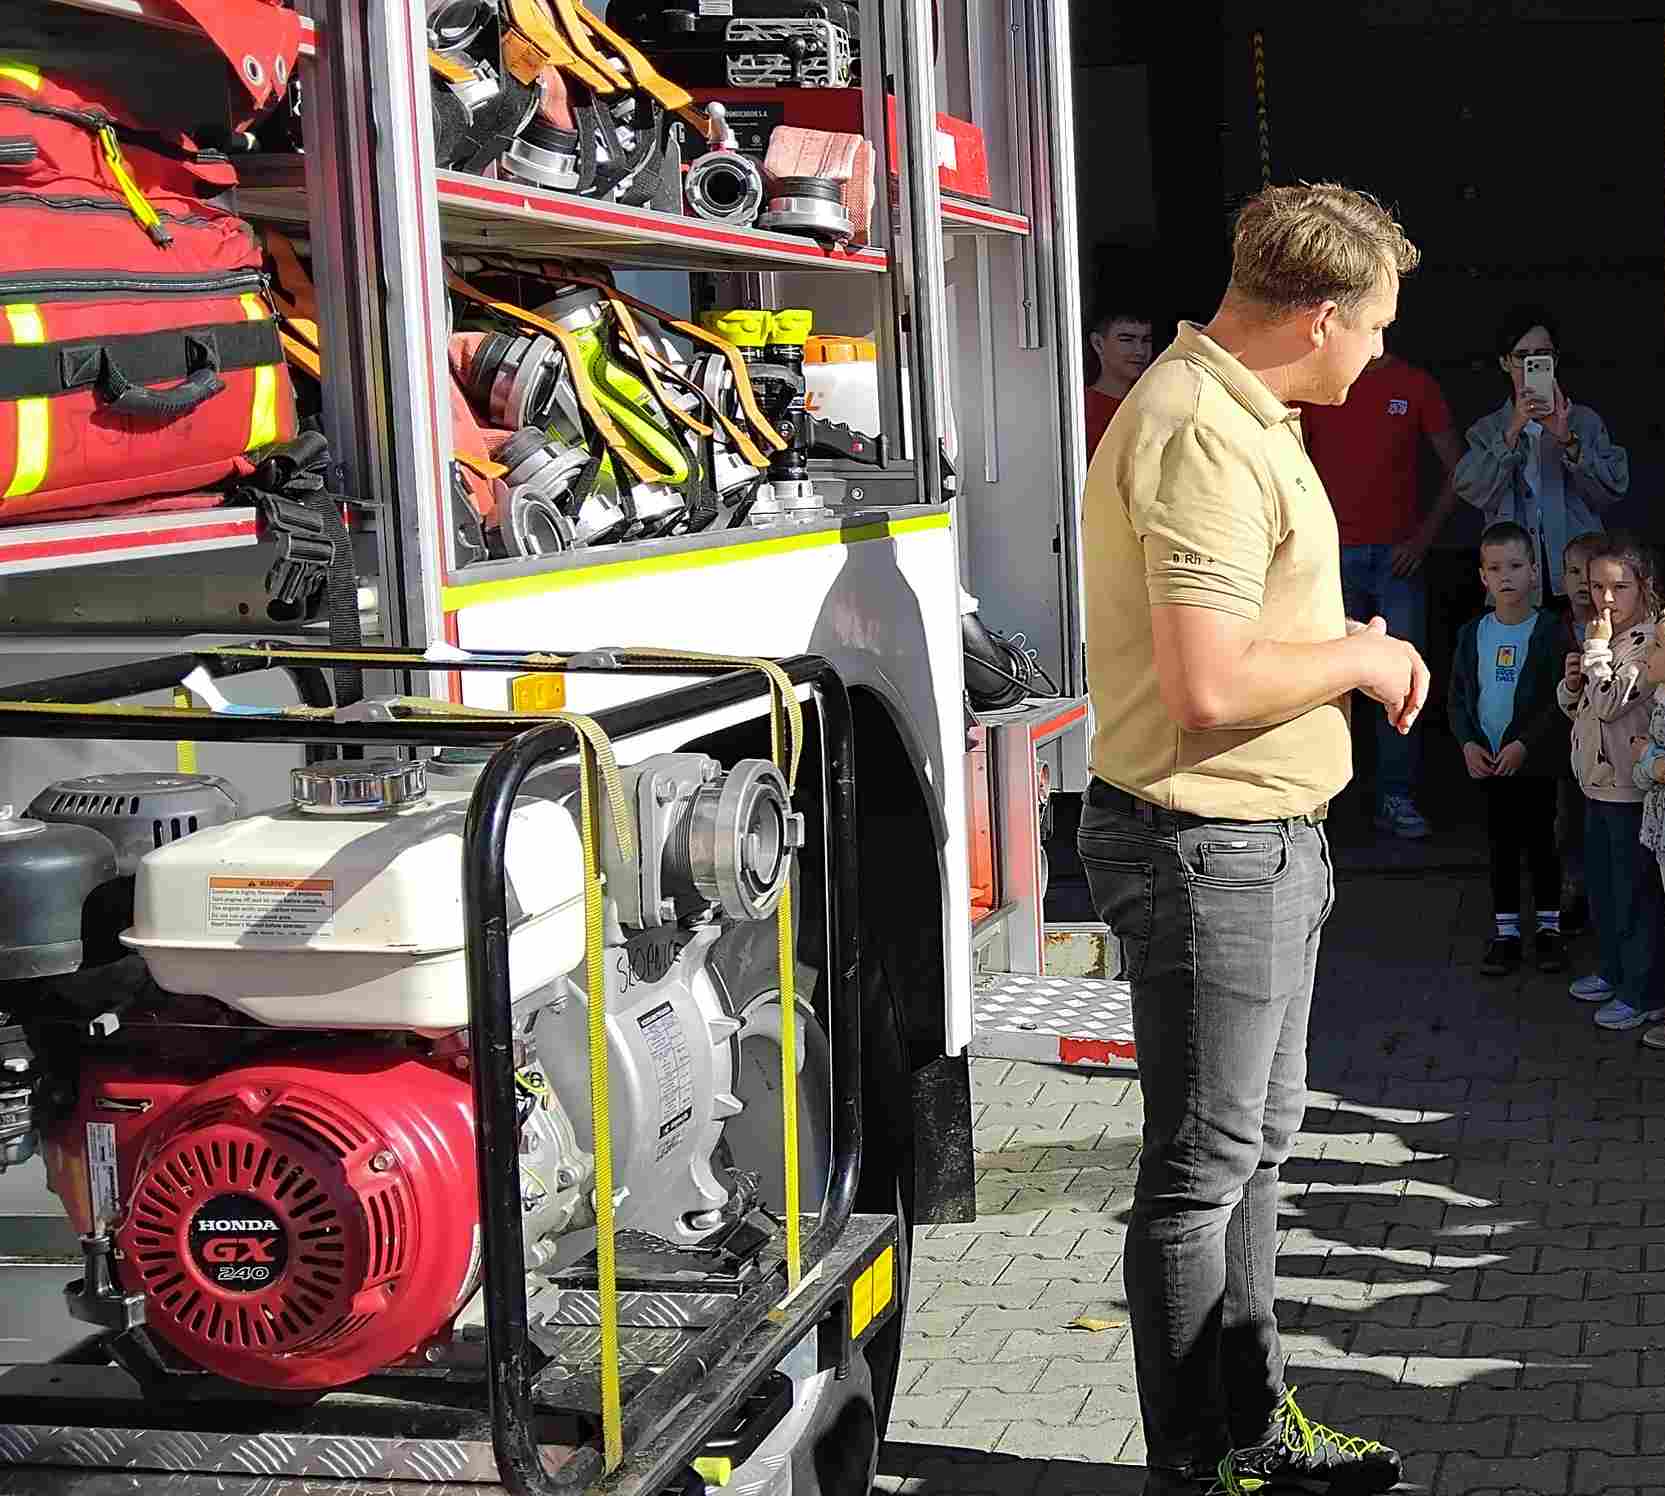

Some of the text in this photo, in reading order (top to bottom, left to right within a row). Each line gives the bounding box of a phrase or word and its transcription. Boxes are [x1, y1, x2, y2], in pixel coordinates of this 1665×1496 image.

[1185, 552, 1201, 565] Rh
[198, 1220, 280, 1231] HONDA
[203, 1238, 276, 1262] GX
[218, 1266, 270, 1281] 240
